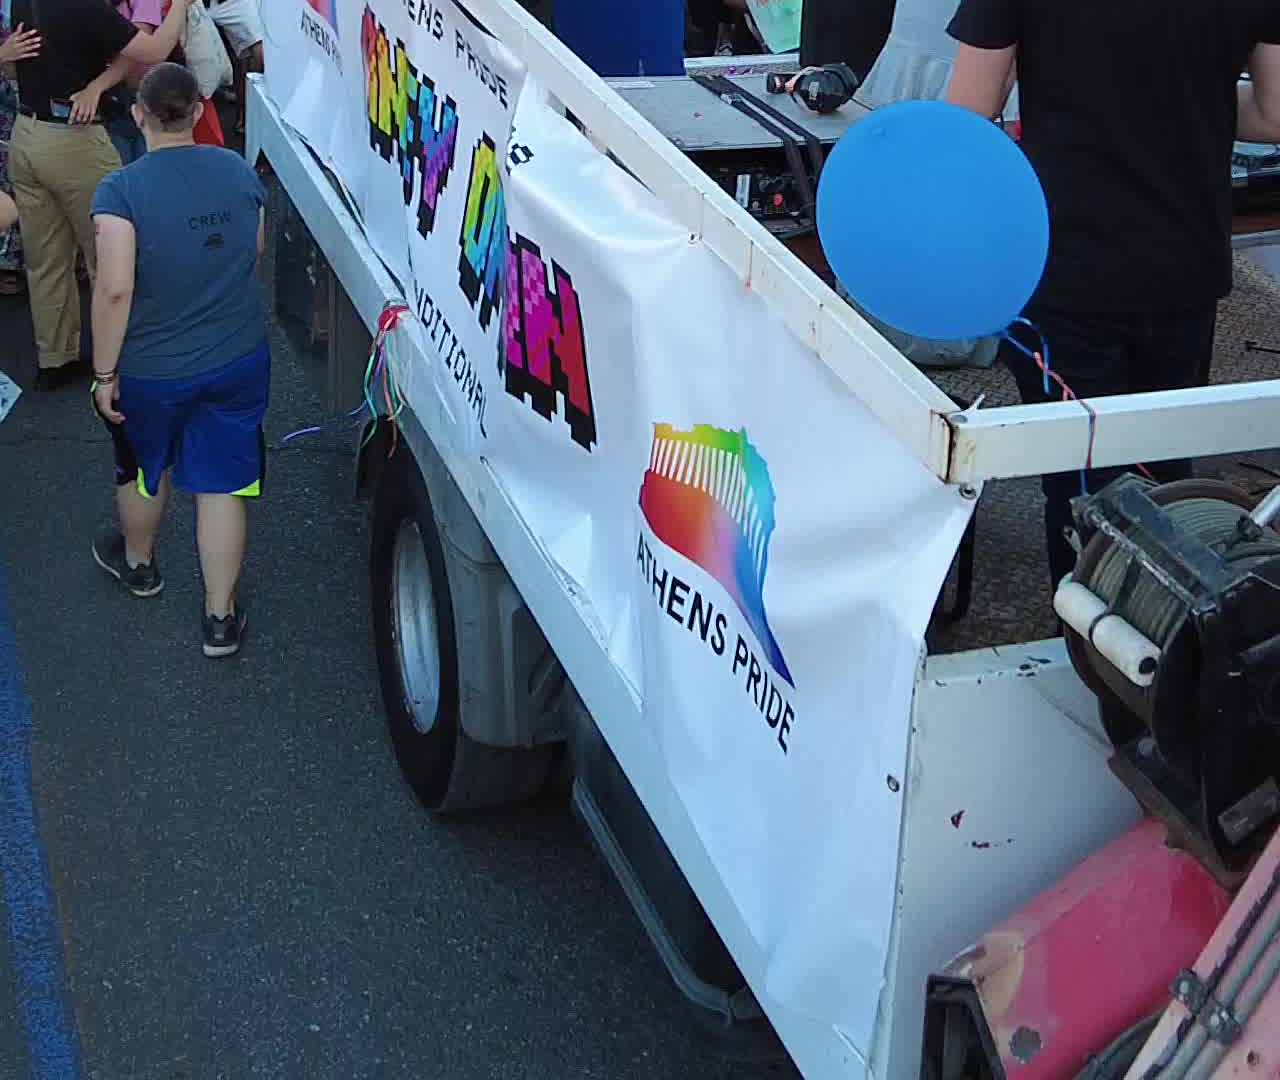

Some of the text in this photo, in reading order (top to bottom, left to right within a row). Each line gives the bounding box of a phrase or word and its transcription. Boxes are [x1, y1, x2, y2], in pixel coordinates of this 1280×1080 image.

[455, 28, 508, 110] PRIDE
[187, 209, 230, 230] CREW
[637, 531, 795, 756] ATHENS PRIDE
